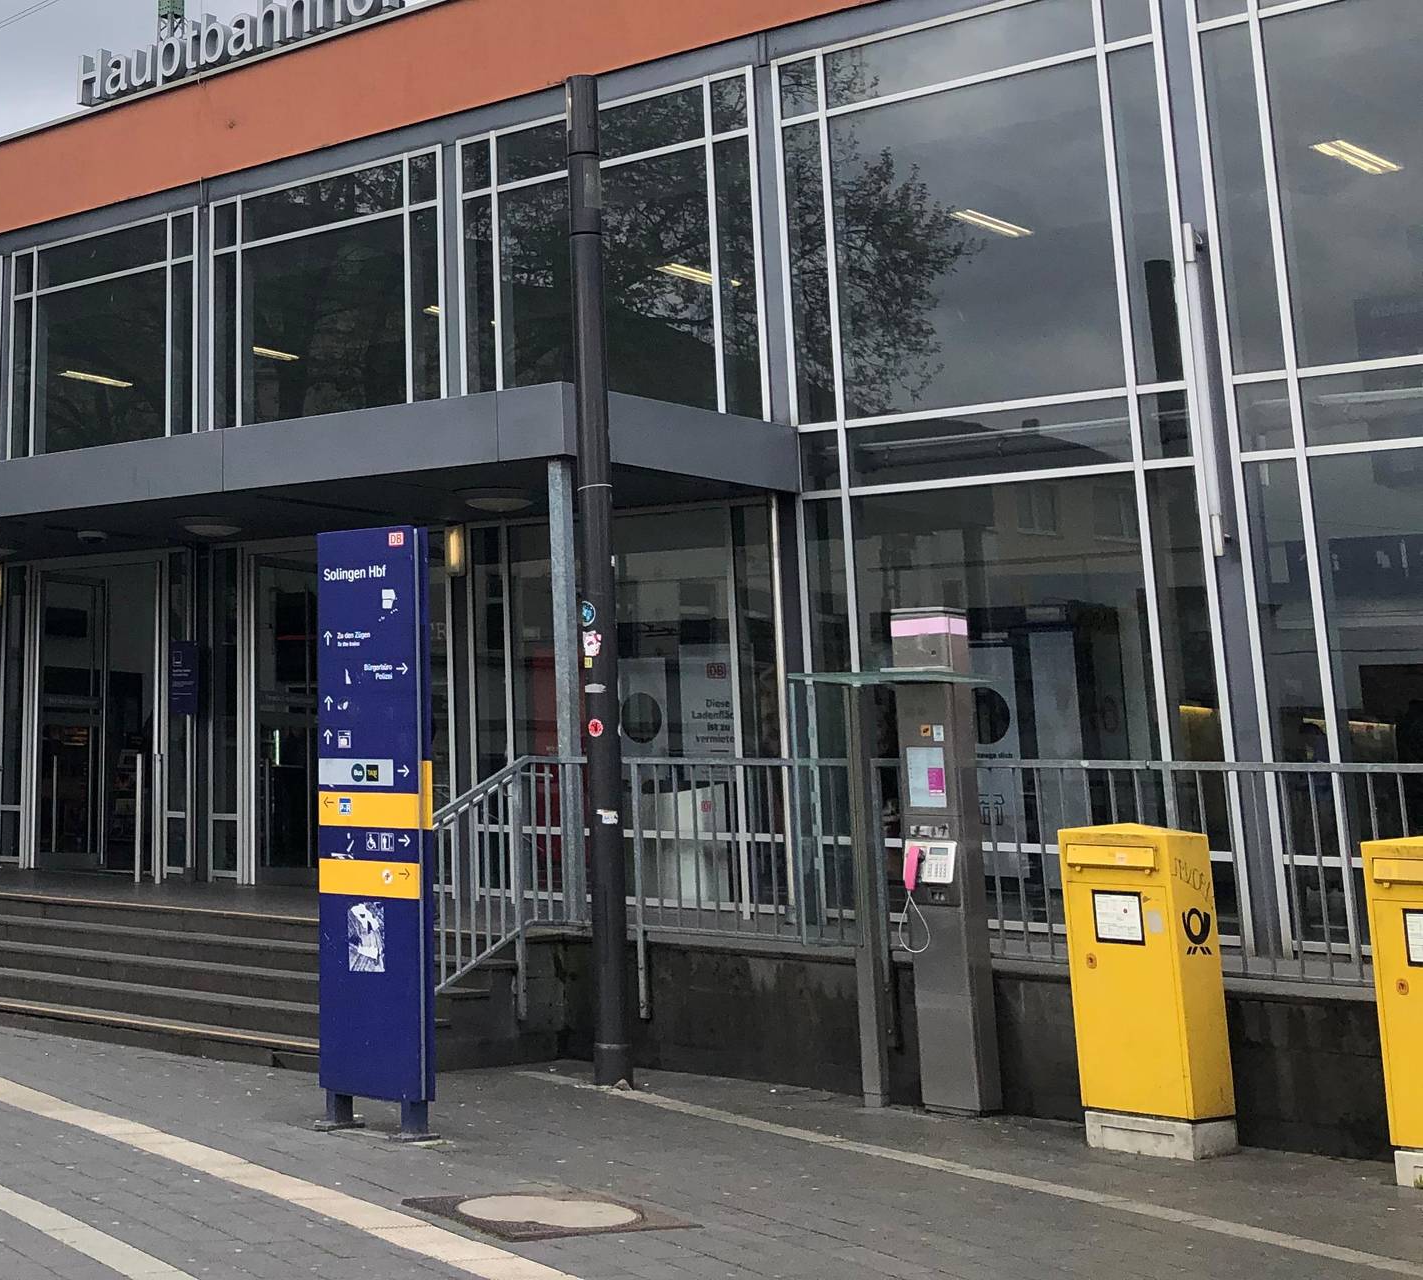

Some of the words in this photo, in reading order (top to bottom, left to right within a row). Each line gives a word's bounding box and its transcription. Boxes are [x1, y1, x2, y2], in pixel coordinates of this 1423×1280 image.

[78, 0, 406, 105] Hauptbahn
[390, 534, 403, 545] DB
[323, 568, 366, 582] Solingen
[368, 564, 386, 578] Hbf
[708, 664, 725, 678] DB
[705, 699, 730, 708] Diese
[691, 710, 735, 720] Ladenfläc
[707, 722, 718, 732] ist
[719, 724, 731, 732] zu
[696, 735, 735, 744] vermiete
